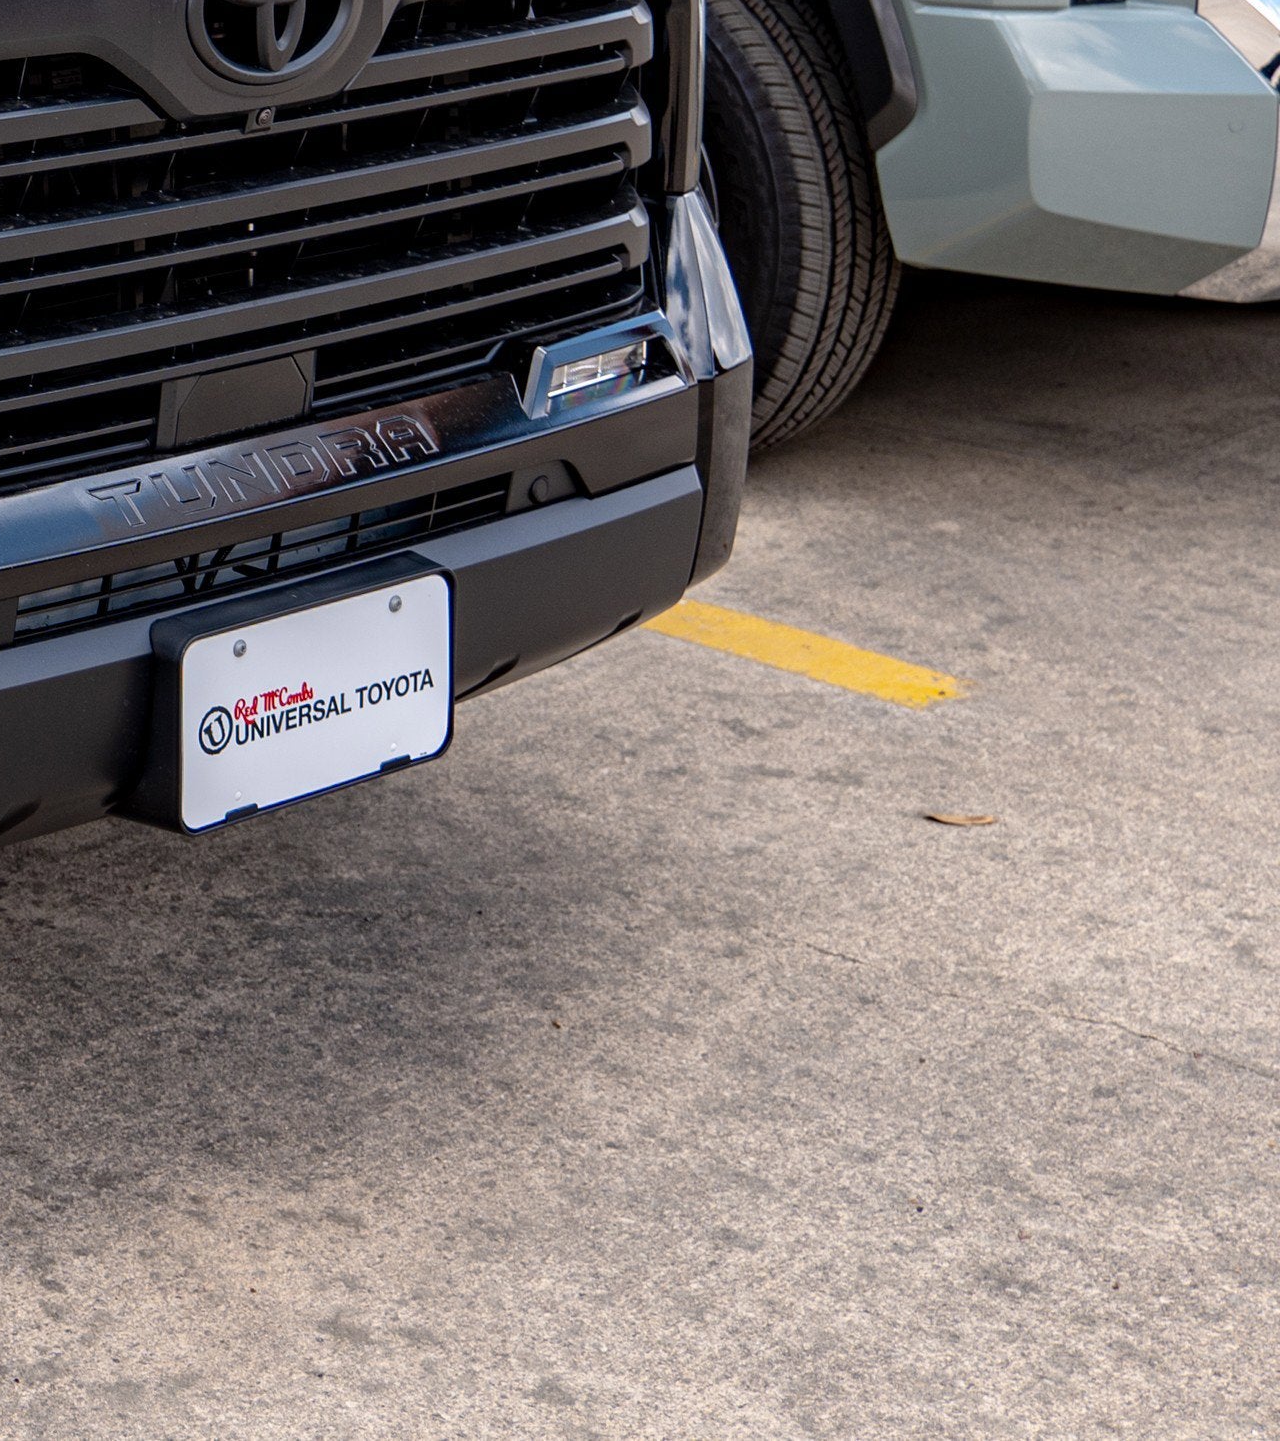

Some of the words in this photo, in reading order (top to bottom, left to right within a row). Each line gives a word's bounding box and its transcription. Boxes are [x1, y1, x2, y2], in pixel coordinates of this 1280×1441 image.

[88, 415, 440, 527] TUNDRA
[234, 696, 259, 726] Red
[259, 681, 314, 713] McCombs
[234, 693, 352, 746] UNIVERSAL
[355, 668, 434, 709] TOYOTA
